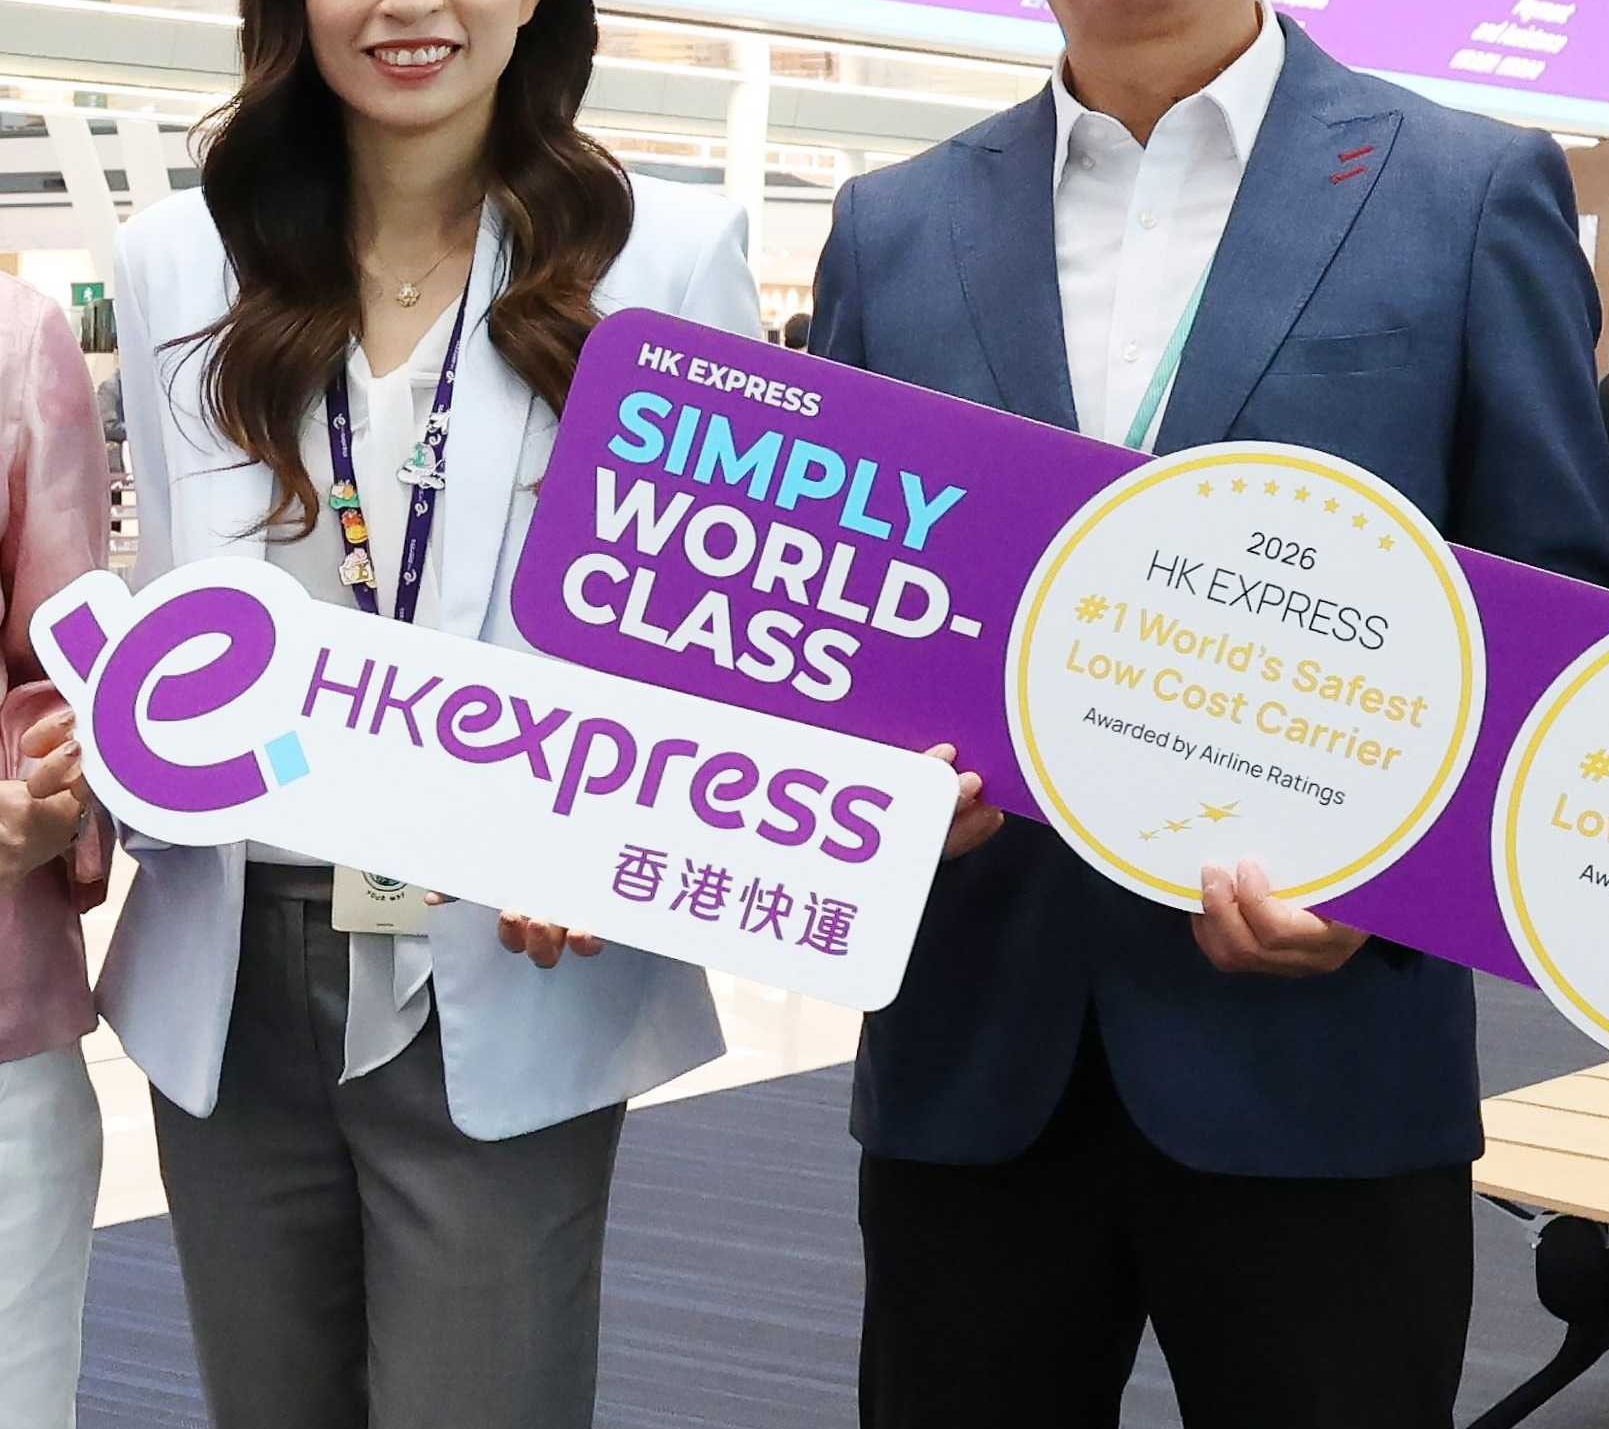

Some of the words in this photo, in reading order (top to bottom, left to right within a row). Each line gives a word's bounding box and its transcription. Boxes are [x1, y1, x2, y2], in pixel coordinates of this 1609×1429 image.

[638, 343, 684, 376] HK
[688, 358, 821, 416] EXPRESS
[608, 392, 966, 550] SIMPLY
[597, 467, 981, 637] WORLD-
[1147, 550, 1204, 594] HK
[1208, 568, 1388, 649] EXPRESS
[1247, 532, 1316, 570] 2026
[563, 554, 860, 701] CLASS
[1076, 595, 1127, 629] #1
[1293, 660, 1428, 727] Safest
[302, 648, 893, 863] HKexpress
[1067, 641, 1145, 688] Low
[1153, 668, 1248, 723] Cost
[1256, 701, 1401, 770] Carrier
[1083, 708, 1170, 747] Awarded
[1173, 736, 1197, 759] by
[1200, 746, 1263, 778] Airline
[1267, 765, 1345, 805] Ratings
[613, 844, 857, 955] 香港快運
